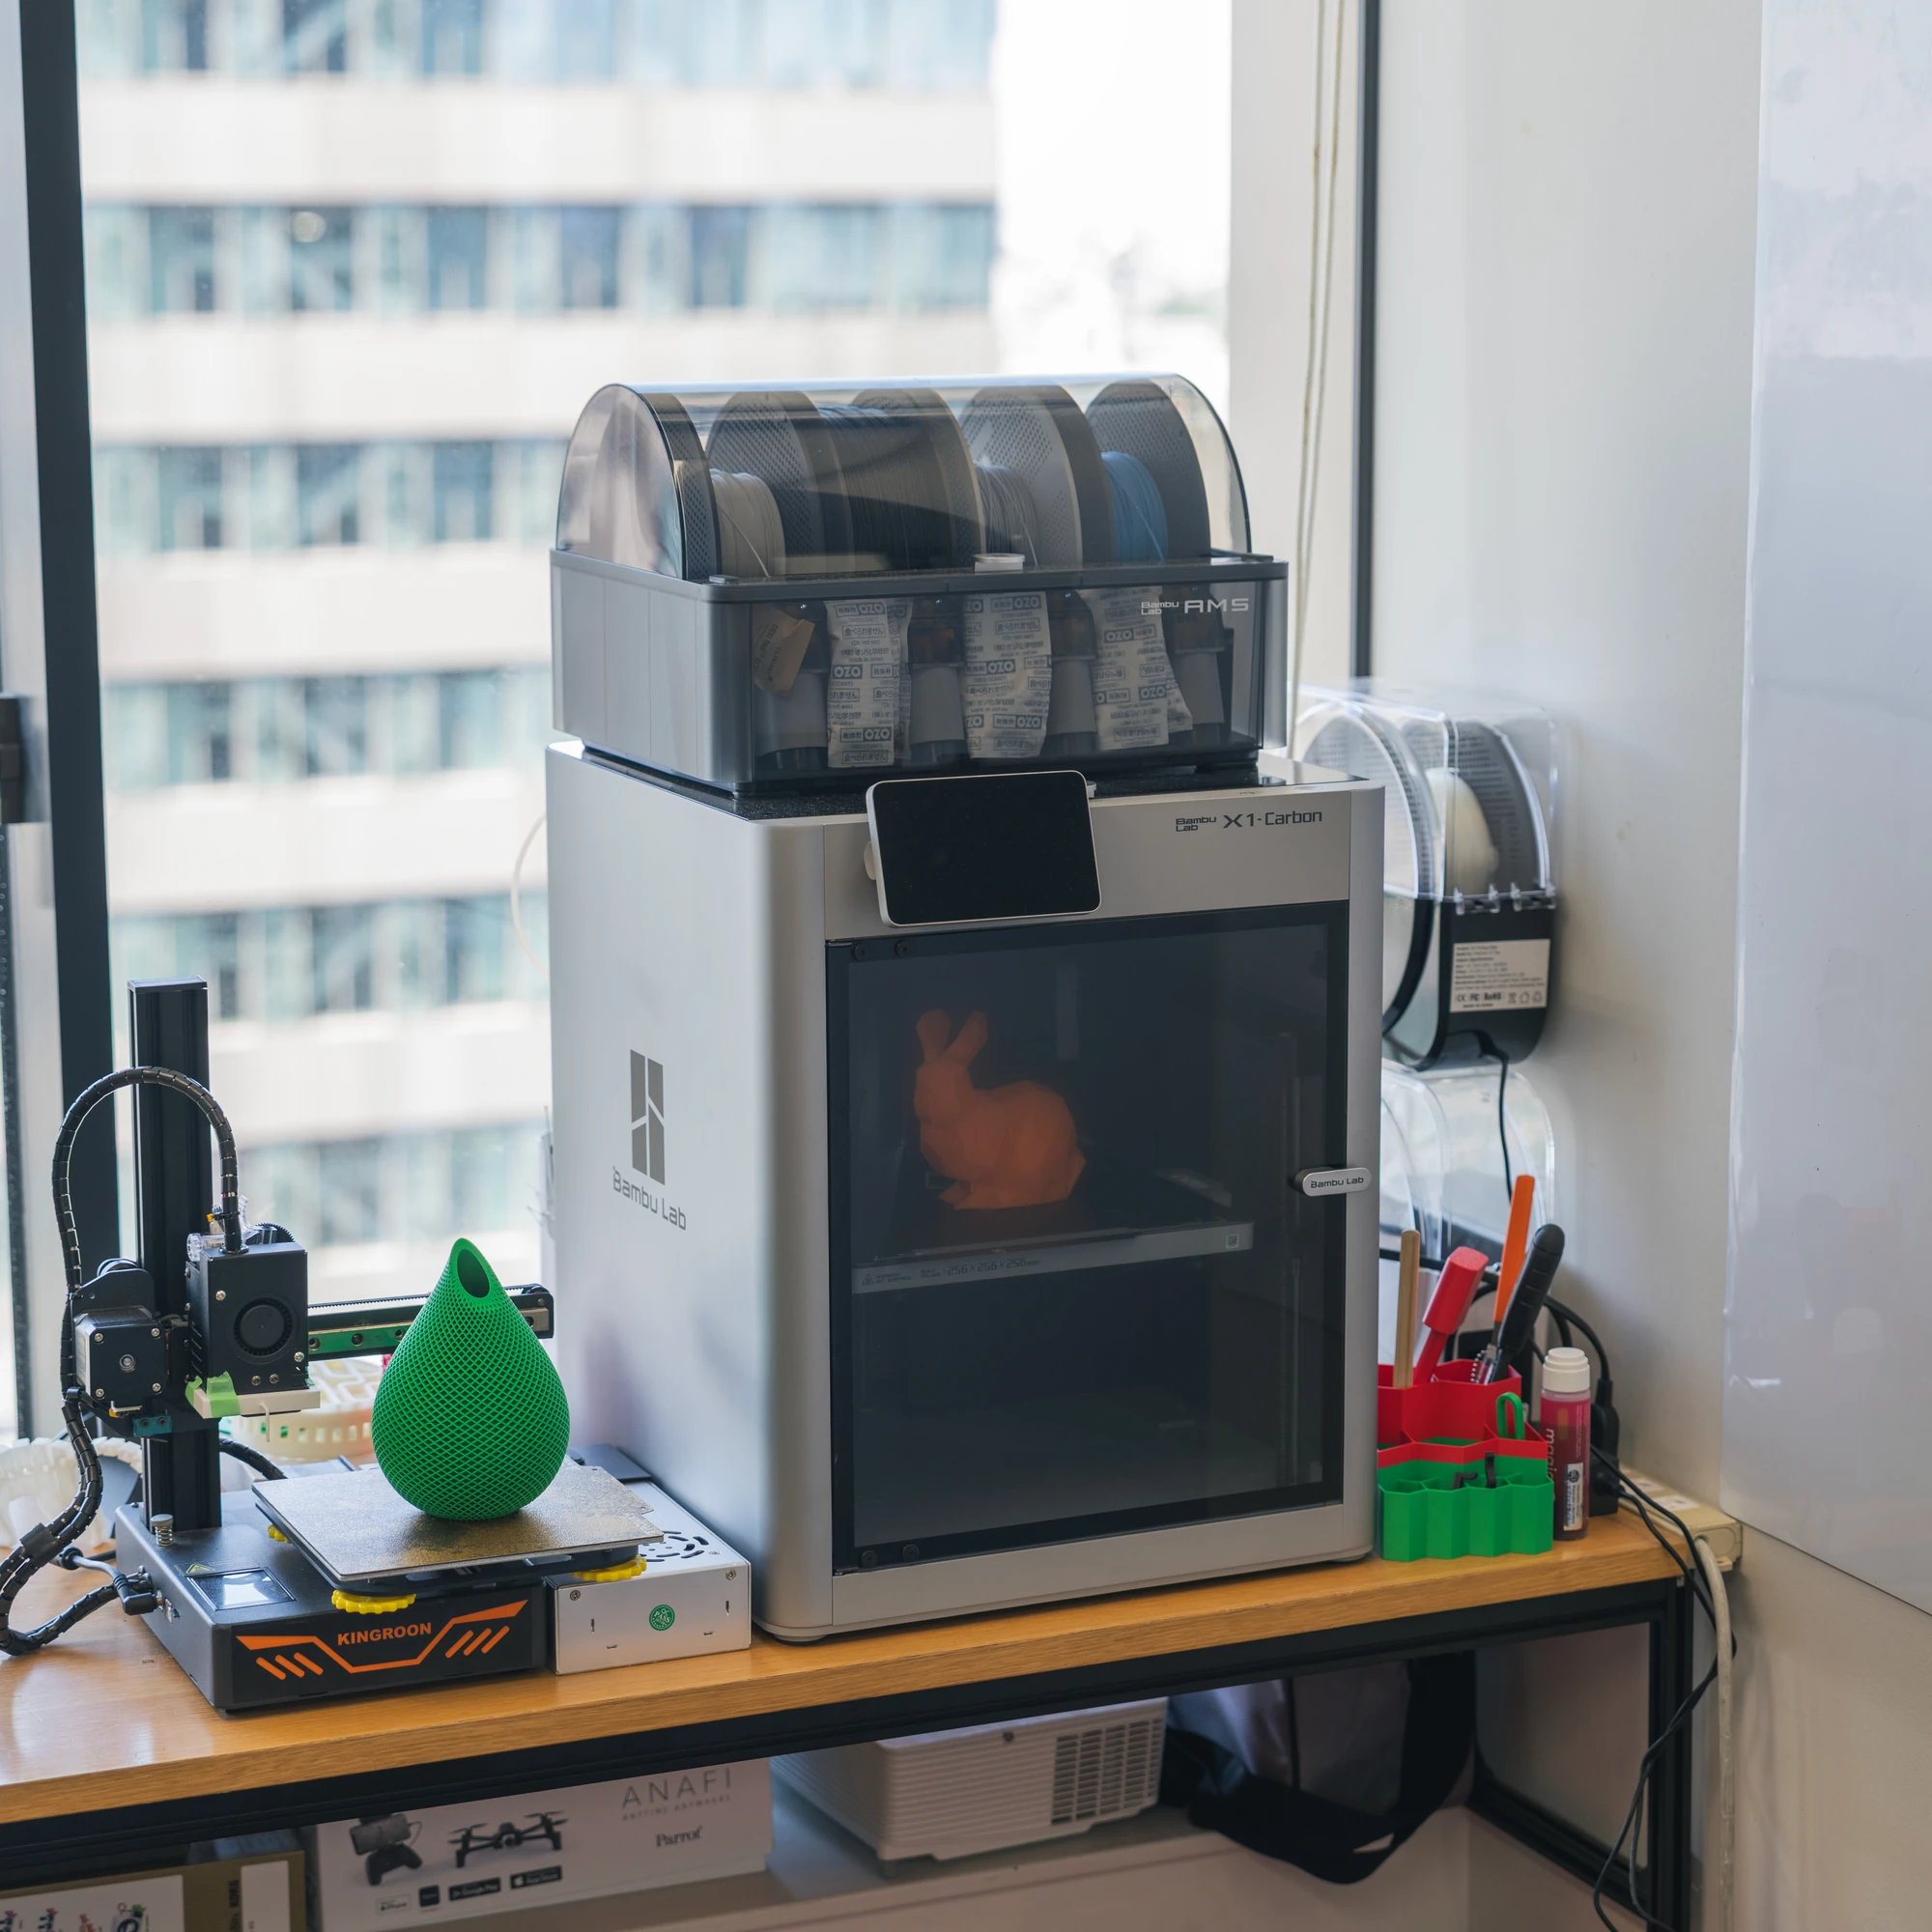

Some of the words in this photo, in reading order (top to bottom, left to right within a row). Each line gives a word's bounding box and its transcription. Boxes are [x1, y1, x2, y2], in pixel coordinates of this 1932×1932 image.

[858, 603, 884, 615] OZO
[1014, 597, 1039, 609] OZO
[1184, 598, 1249, 613] AMS
[1106, 630, 1132, 641] OZO
[834, 667, 861, 678] OZO
[988, 661, 1014, 673] OZO
[1140, 687, 1166, 698] OZO
[1017, 717, 1040, 727] OZO
[865, 728, 891, 741] OZO
[1176, 816, 1216, 825] Bambu
[1223, 810, 1322, 829] X1-Carbon
[1310, 1179, 1344, 1188] Bambu
[1347, 1177, 1364, 1185] Lab
[612, 1166, 658, 1214] Bambu
[662, 1197, 687, 1231] Lab
[337, 1623, 432, 1646] KINGROON
[621, 1767, 731, 1809] ANAFI
[656, 1824, 703, 1848] Parrot
